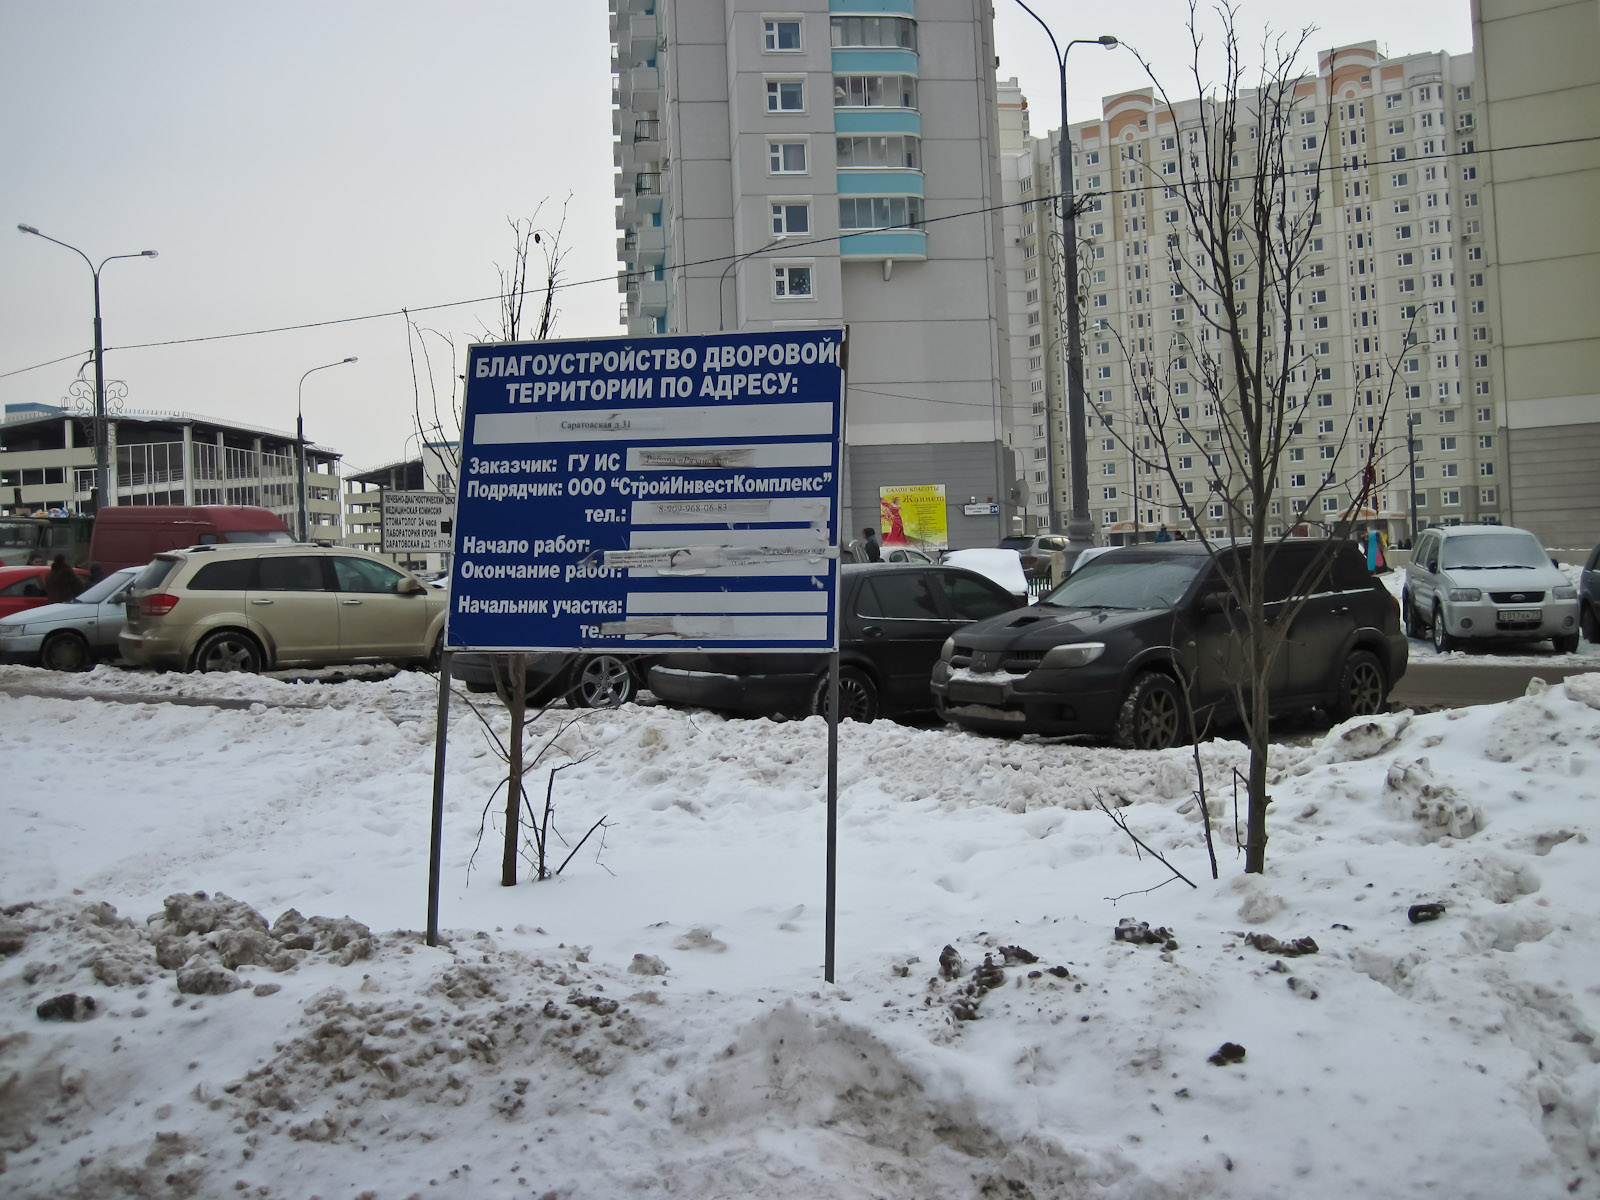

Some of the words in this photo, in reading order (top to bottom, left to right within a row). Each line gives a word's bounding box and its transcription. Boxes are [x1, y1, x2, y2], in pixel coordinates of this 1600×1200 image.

[475, 345, 697, 378] БЛАГОУСТРОЙСТВО
[702, 337, 835, 372] ДВОРОВОЙ
[506, 376, 653, 404] ТЕРРИТОРИИ
[660, 375, 693, 399] ПО
[699, 372, 799, 400] АДРЕСУ:
[561, 420, 612, 431] Саратовская
[469, 456, 557, 476] Заказчик:
[568, 455, 592, 472] ГУ
[594, 453, 621, 472] ИС
[467, 480, 563, 501] Подрядчик:
[567, 477, 605, 496] ООО
[385, 517, 417, 526] СТОМАТОЛОГ
[418, 517, 424, 526] 24
[585, 507, 627, 523] тел.:
[385, 529, 420, 538] ЛАБОРАТОРИЯ
[421, 530, 437, 538] КРОВИ
[385, 540, 420, 548] САРАТОВСКАЯ
[463, 537, 529, 554] Начало
[534, 535, 591, 557] работ:
[461, 562, 560, 580] Окончание
[458, 595, 548, 615] Начальник
[552, 598, 623, 618] участка:
